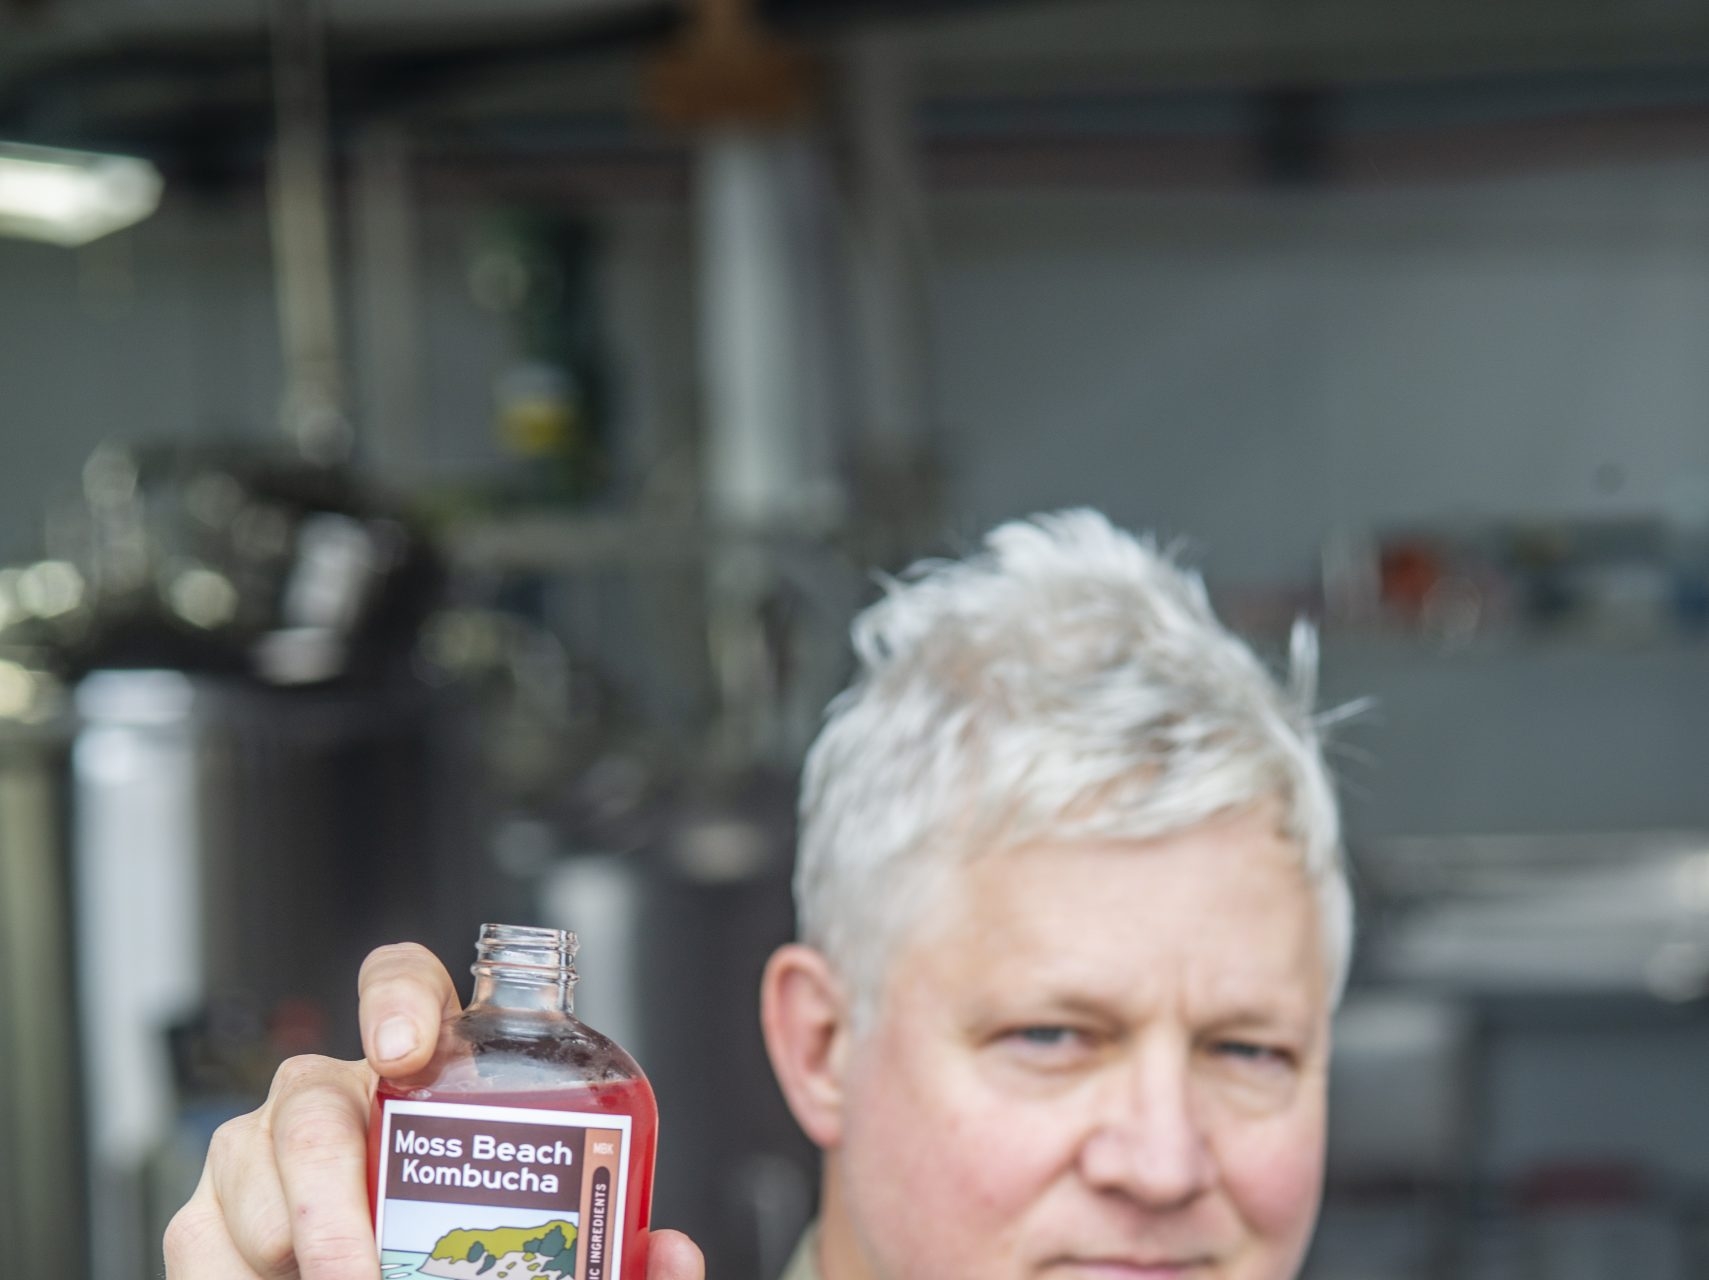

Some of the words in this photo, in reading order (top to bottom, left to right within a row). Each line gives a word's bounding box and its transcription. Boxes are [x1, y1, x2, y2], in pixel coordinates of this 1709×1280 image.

[395, 1129, 463, 1158] Moss
[472, 1134, 573, 1165] Beach
[592, 1142, 614, 1156] MBK
[402, 1158, 559, 1193] Kombucha
[590, 1183, 608, 1265] INGREDIENTS
